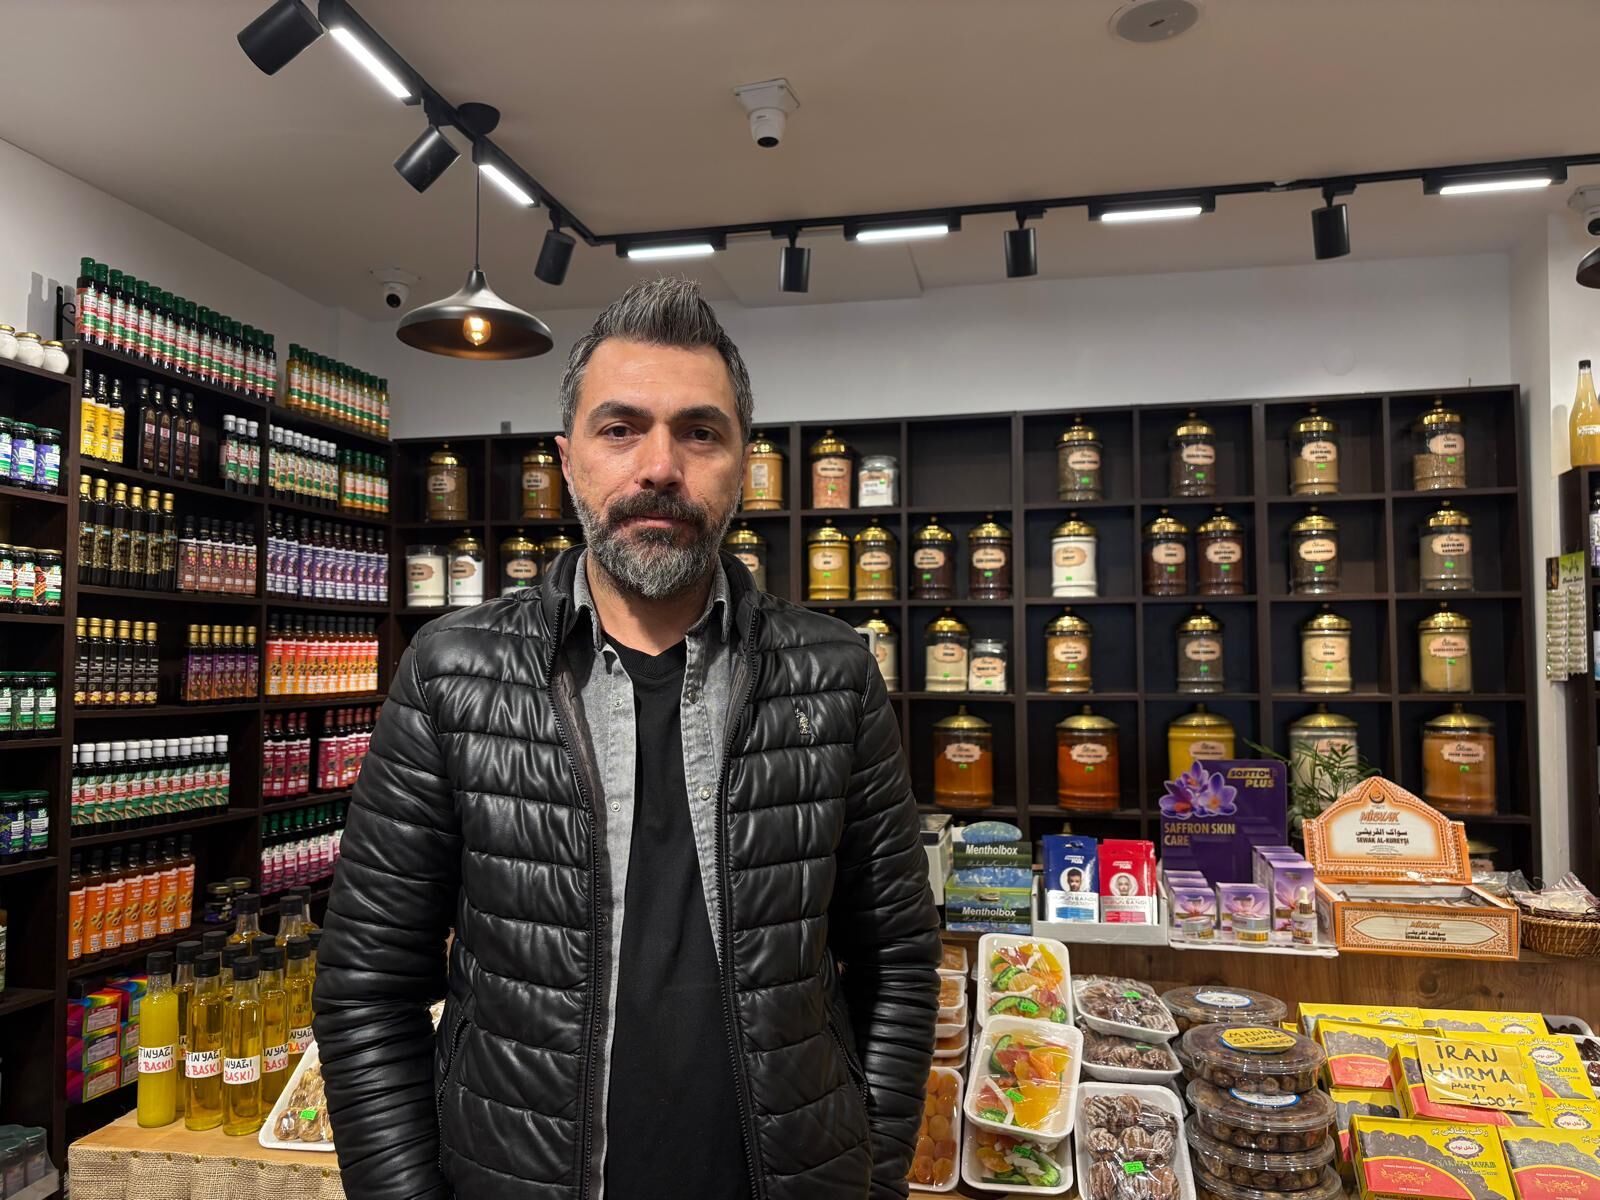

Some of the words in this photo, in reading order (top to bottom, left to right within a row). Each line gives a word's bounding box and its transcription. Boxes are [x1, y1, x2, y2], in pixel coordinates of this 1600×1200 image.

[1244, 779, 1275, 788] PLUS
[1164, 823, 1209, 834] SAFFRON
[1211, 823, 1236, 834] SKIN
[1164, 835, 1190, 846] CARE
[965, 844, 1018, 856] Mentholbox
[962, 906, 1016, 918] Mentholbox
[1435, 1040, 1498, 1062] İRAN
[1428, 1062, 1515, 1085] HURMA
